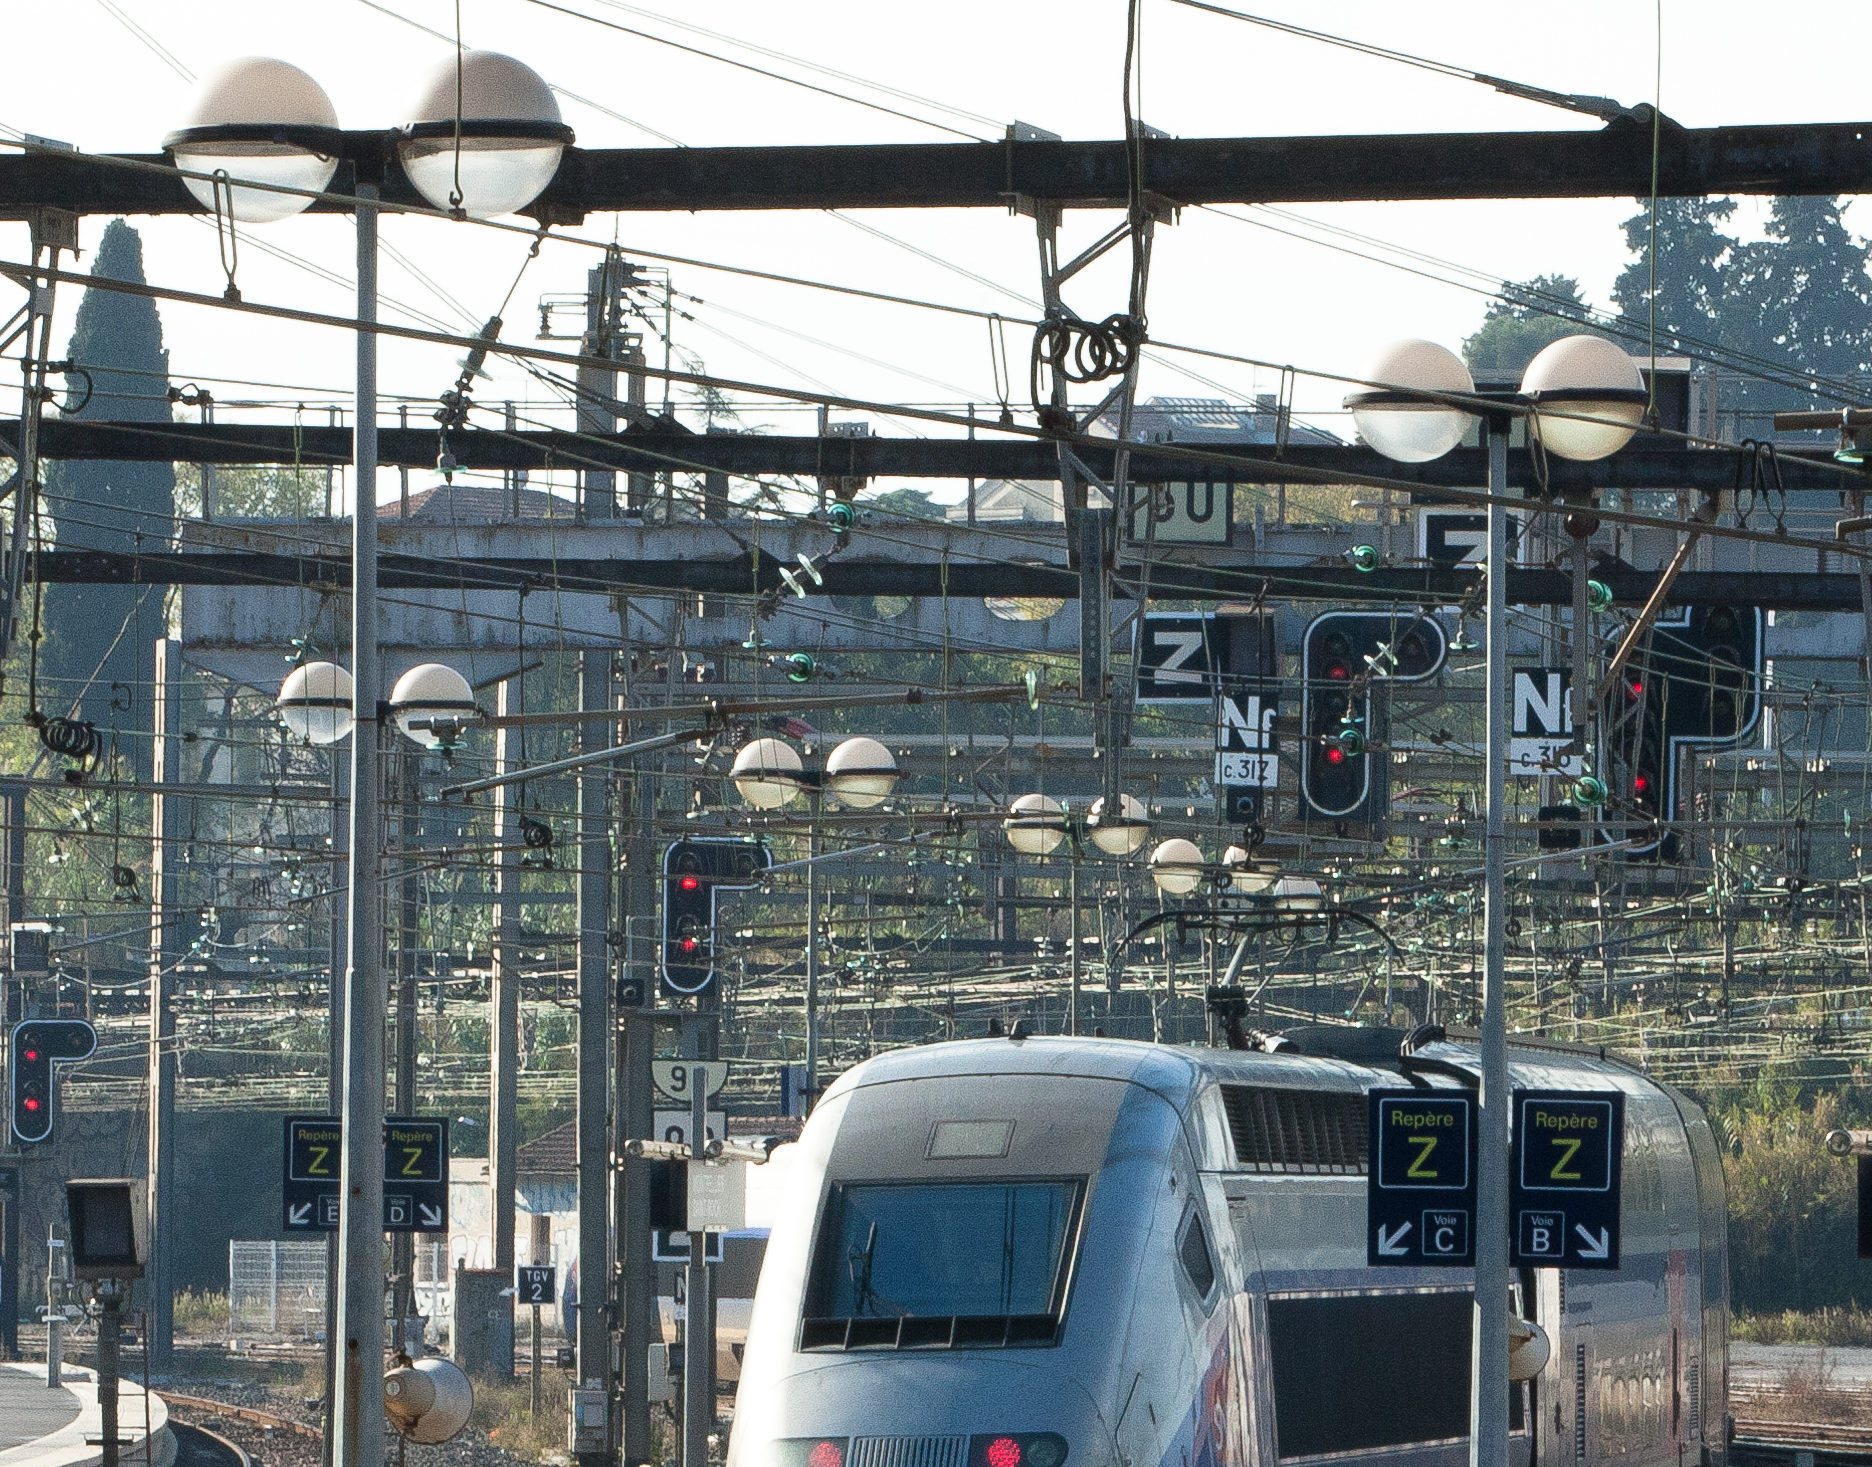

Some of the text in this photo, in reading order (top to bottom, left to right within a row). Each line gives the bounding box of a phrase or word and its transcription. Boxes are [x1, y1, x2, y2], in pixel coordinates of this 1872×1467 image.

[1153, 631, 1204, 685] Z
[1220, 695, 1277, 749] Nf
[1391, 1111, 1454, 1128] Repère
[1535, 1112, 1598, 1129] Repère
[308, 1146, 329, 1174] Z
[401, 1147, 423, 1175] Z
[1407, 1136, 1438, 1178] Z
[1550, 1138, 1582, 1180] Z
[390, 1206, 404, 1222] D
[1434, 1215, 1457, 1225] Voie
[1531, 1215, 1554, 1226] Voie
[1434, 1228, 1455, 1252] C
[1532, 1229, 1550, 1252] B
[526, 1269, 549, 1283] TGV
[531, 1283, 543, 1301] 2
